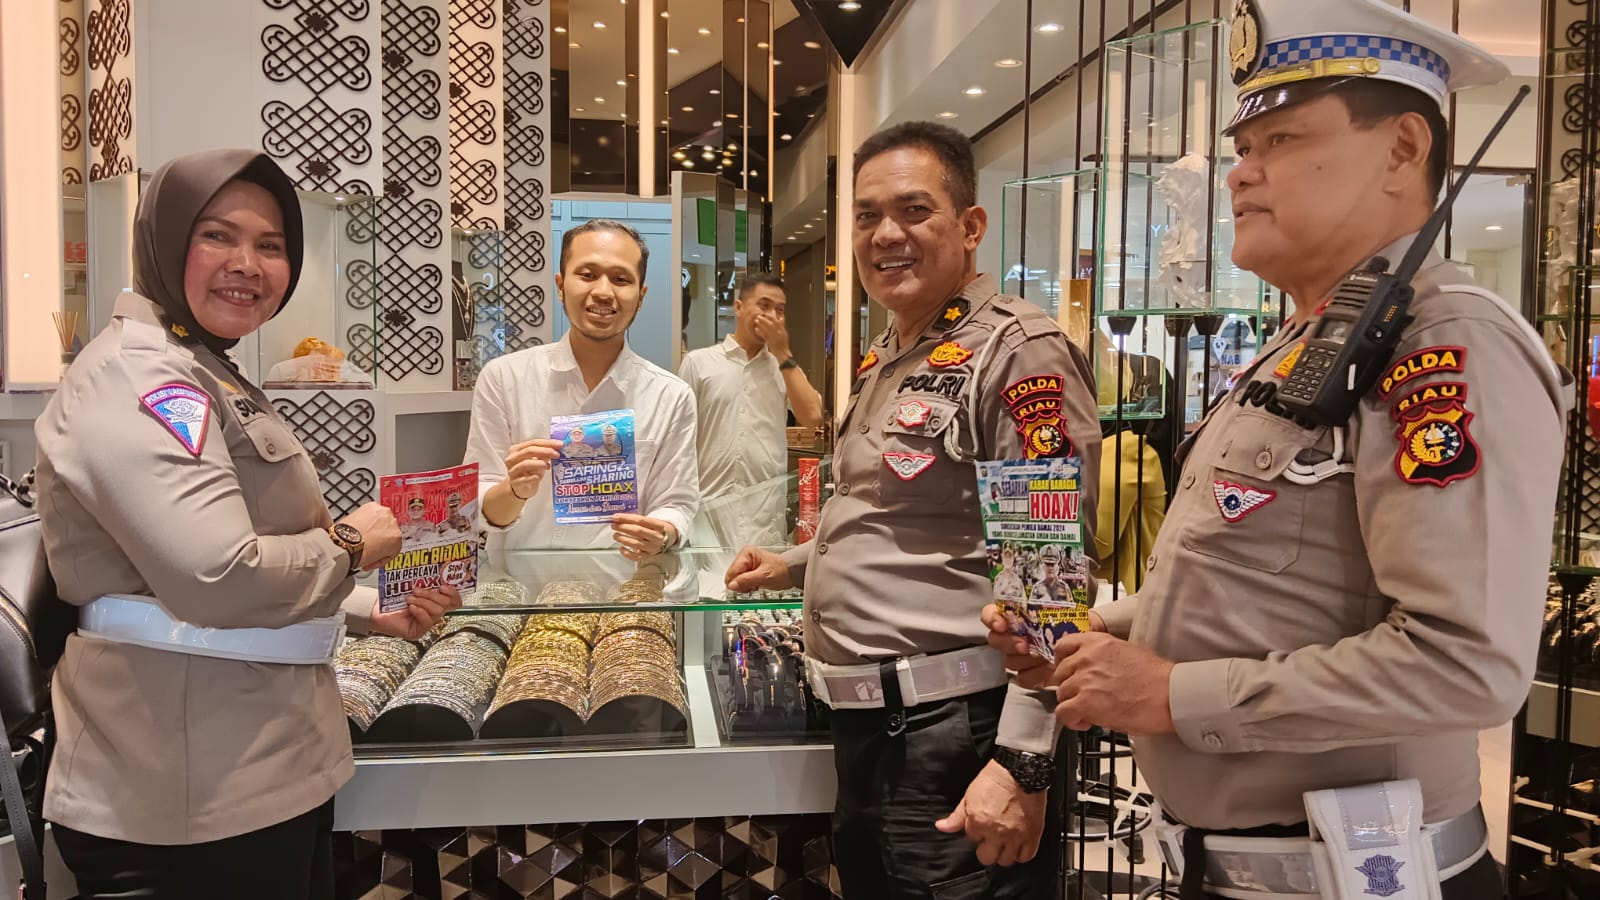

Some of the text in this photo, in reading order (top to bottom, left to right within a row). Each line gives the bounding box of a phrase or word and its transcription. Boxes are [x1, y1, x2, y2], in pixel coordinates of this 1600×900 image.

[1382, 351, 1457, 392] POLDA
[897, 374, 966, 396] POLRI
[1008, 378, 1058, 400] POLDA
[1399, 385, 1457, 411] RIAU
[1018, 401, 1056, 418] RIAU
[564, 462, 617, 479] SARING
[587, 470, 635, 484] SHARING
[556, 482, 634, 497] STOP HOAX
[1030, 492, 1079, 520] HOAX!
[431, 541, 468, 565] BIJAK
[386, 564, 438, 582] TAK PERCAYA
[385, 577, 440, 597] HOAX
